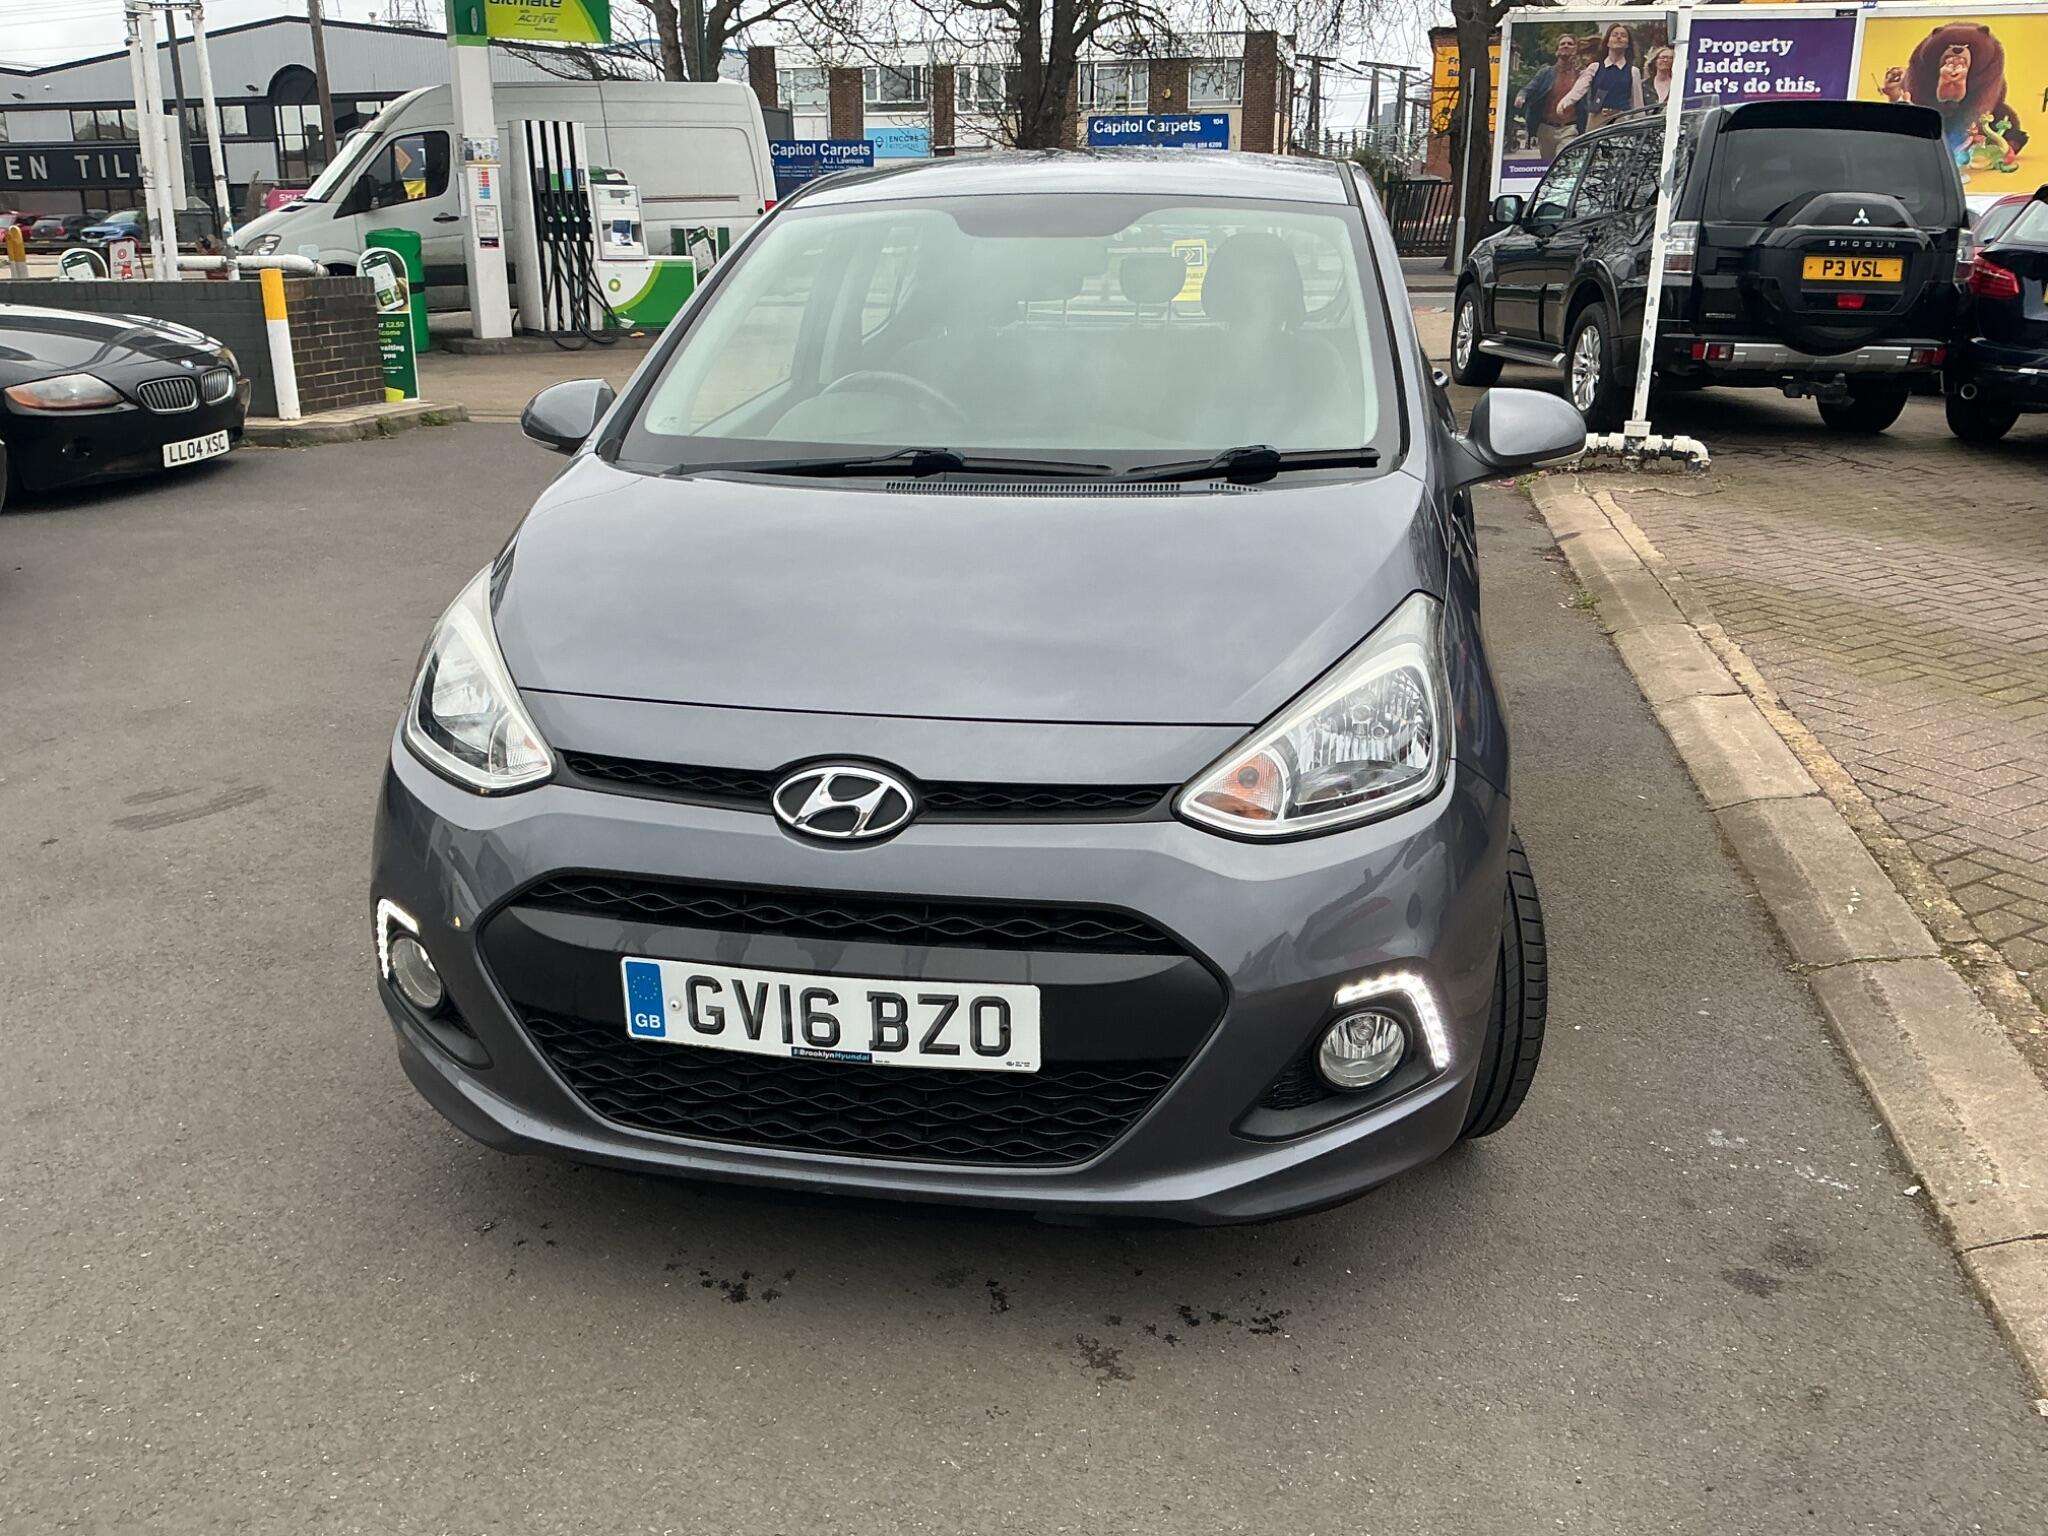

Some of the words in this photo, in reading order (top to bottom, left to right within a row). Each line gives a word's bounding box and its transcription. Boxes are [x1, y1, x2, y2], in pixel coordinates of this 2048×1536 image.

[518, 14, 557, 24] ACTIVE
[1698, 38, 1793, 56] Property
[1696, 58, 1771, 75] ladder,
[1694, 78, 1739, 93] let's
[1744, 78, 1771, 93] do
[1775, 76, 1821, 93] this.
[1093, 120, 1143, 136] Capitol
[1147, 119, 1202, 135] Carpets
[771, 143, 816, 158] Capitol
[819, 143, 871, 158] Carpets
[4, 155, 48, 180] EN
[1508, 165, 1550, 173] Tomorrow
[1828, 240, 1896, 248] SHOGUN
[1823, 260, 1846, 277] P3
[1851, 260, 1883, 278] VSL
[169, 440, 203, 463] LL04
[205, 433, 226, 455] XSC
[635, 1013, 661, 1029] GB
[685, 974, 841, 1048] GV16
[866, 990, 1012, 1058] BZO
